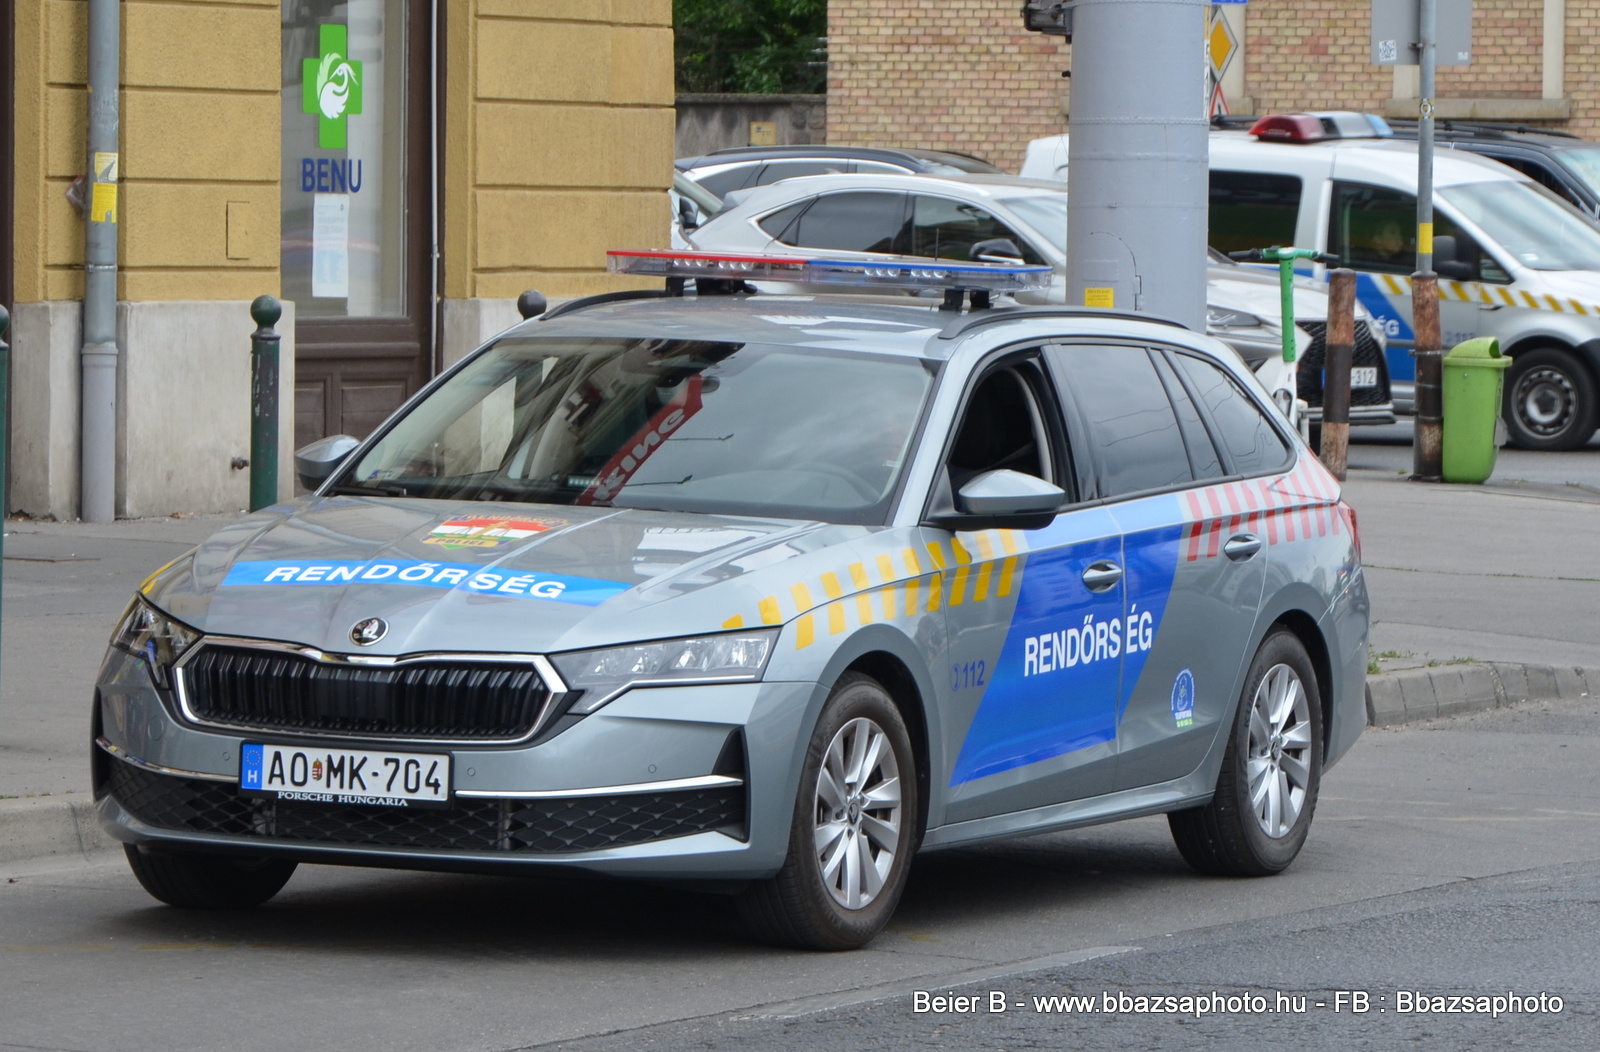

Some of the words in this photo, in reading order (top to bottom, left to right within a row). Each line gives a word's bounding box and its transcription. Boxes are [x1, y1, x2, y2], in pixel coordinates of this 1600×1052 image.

[302, 158, 362, 193] BENU
[1351, 369, 1375, 385] -312
[263, 562, 567, 599] RENDŐRSÉG
[963, 660, 986, 689] 112
[247, 769, 259, 784] H
[268, 750, 309, 787] AO
[326, 754, 442, 795] MK-704
[277, 791, 334, 803] PORSCHE
[338, 795, 409, 807] HUNGARIA
